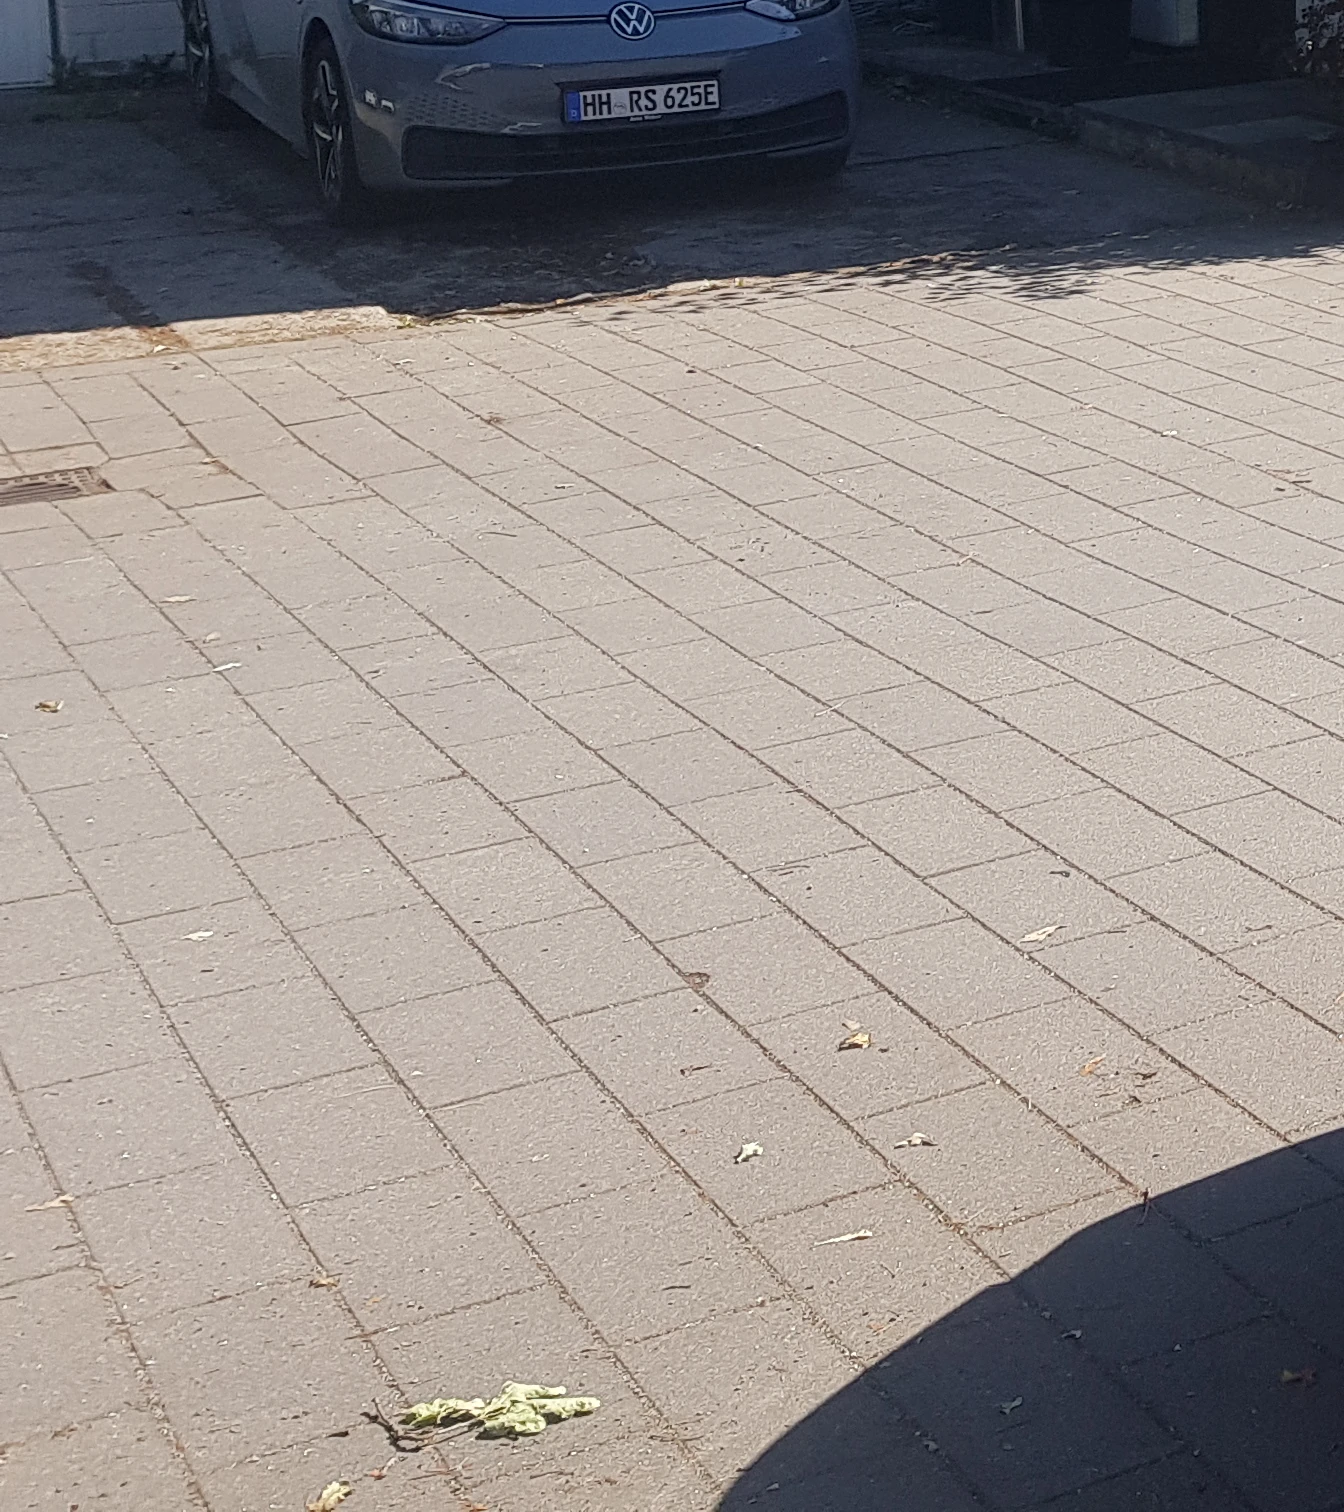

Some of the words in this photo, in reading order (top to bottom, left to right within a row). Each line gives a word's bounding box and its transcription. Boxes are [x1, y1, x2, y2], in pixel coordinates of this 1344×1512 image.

[583, 92, 612, 117] HH
[628, 89, 657, 113] RS
[663, 83, 717, 110] 625E
